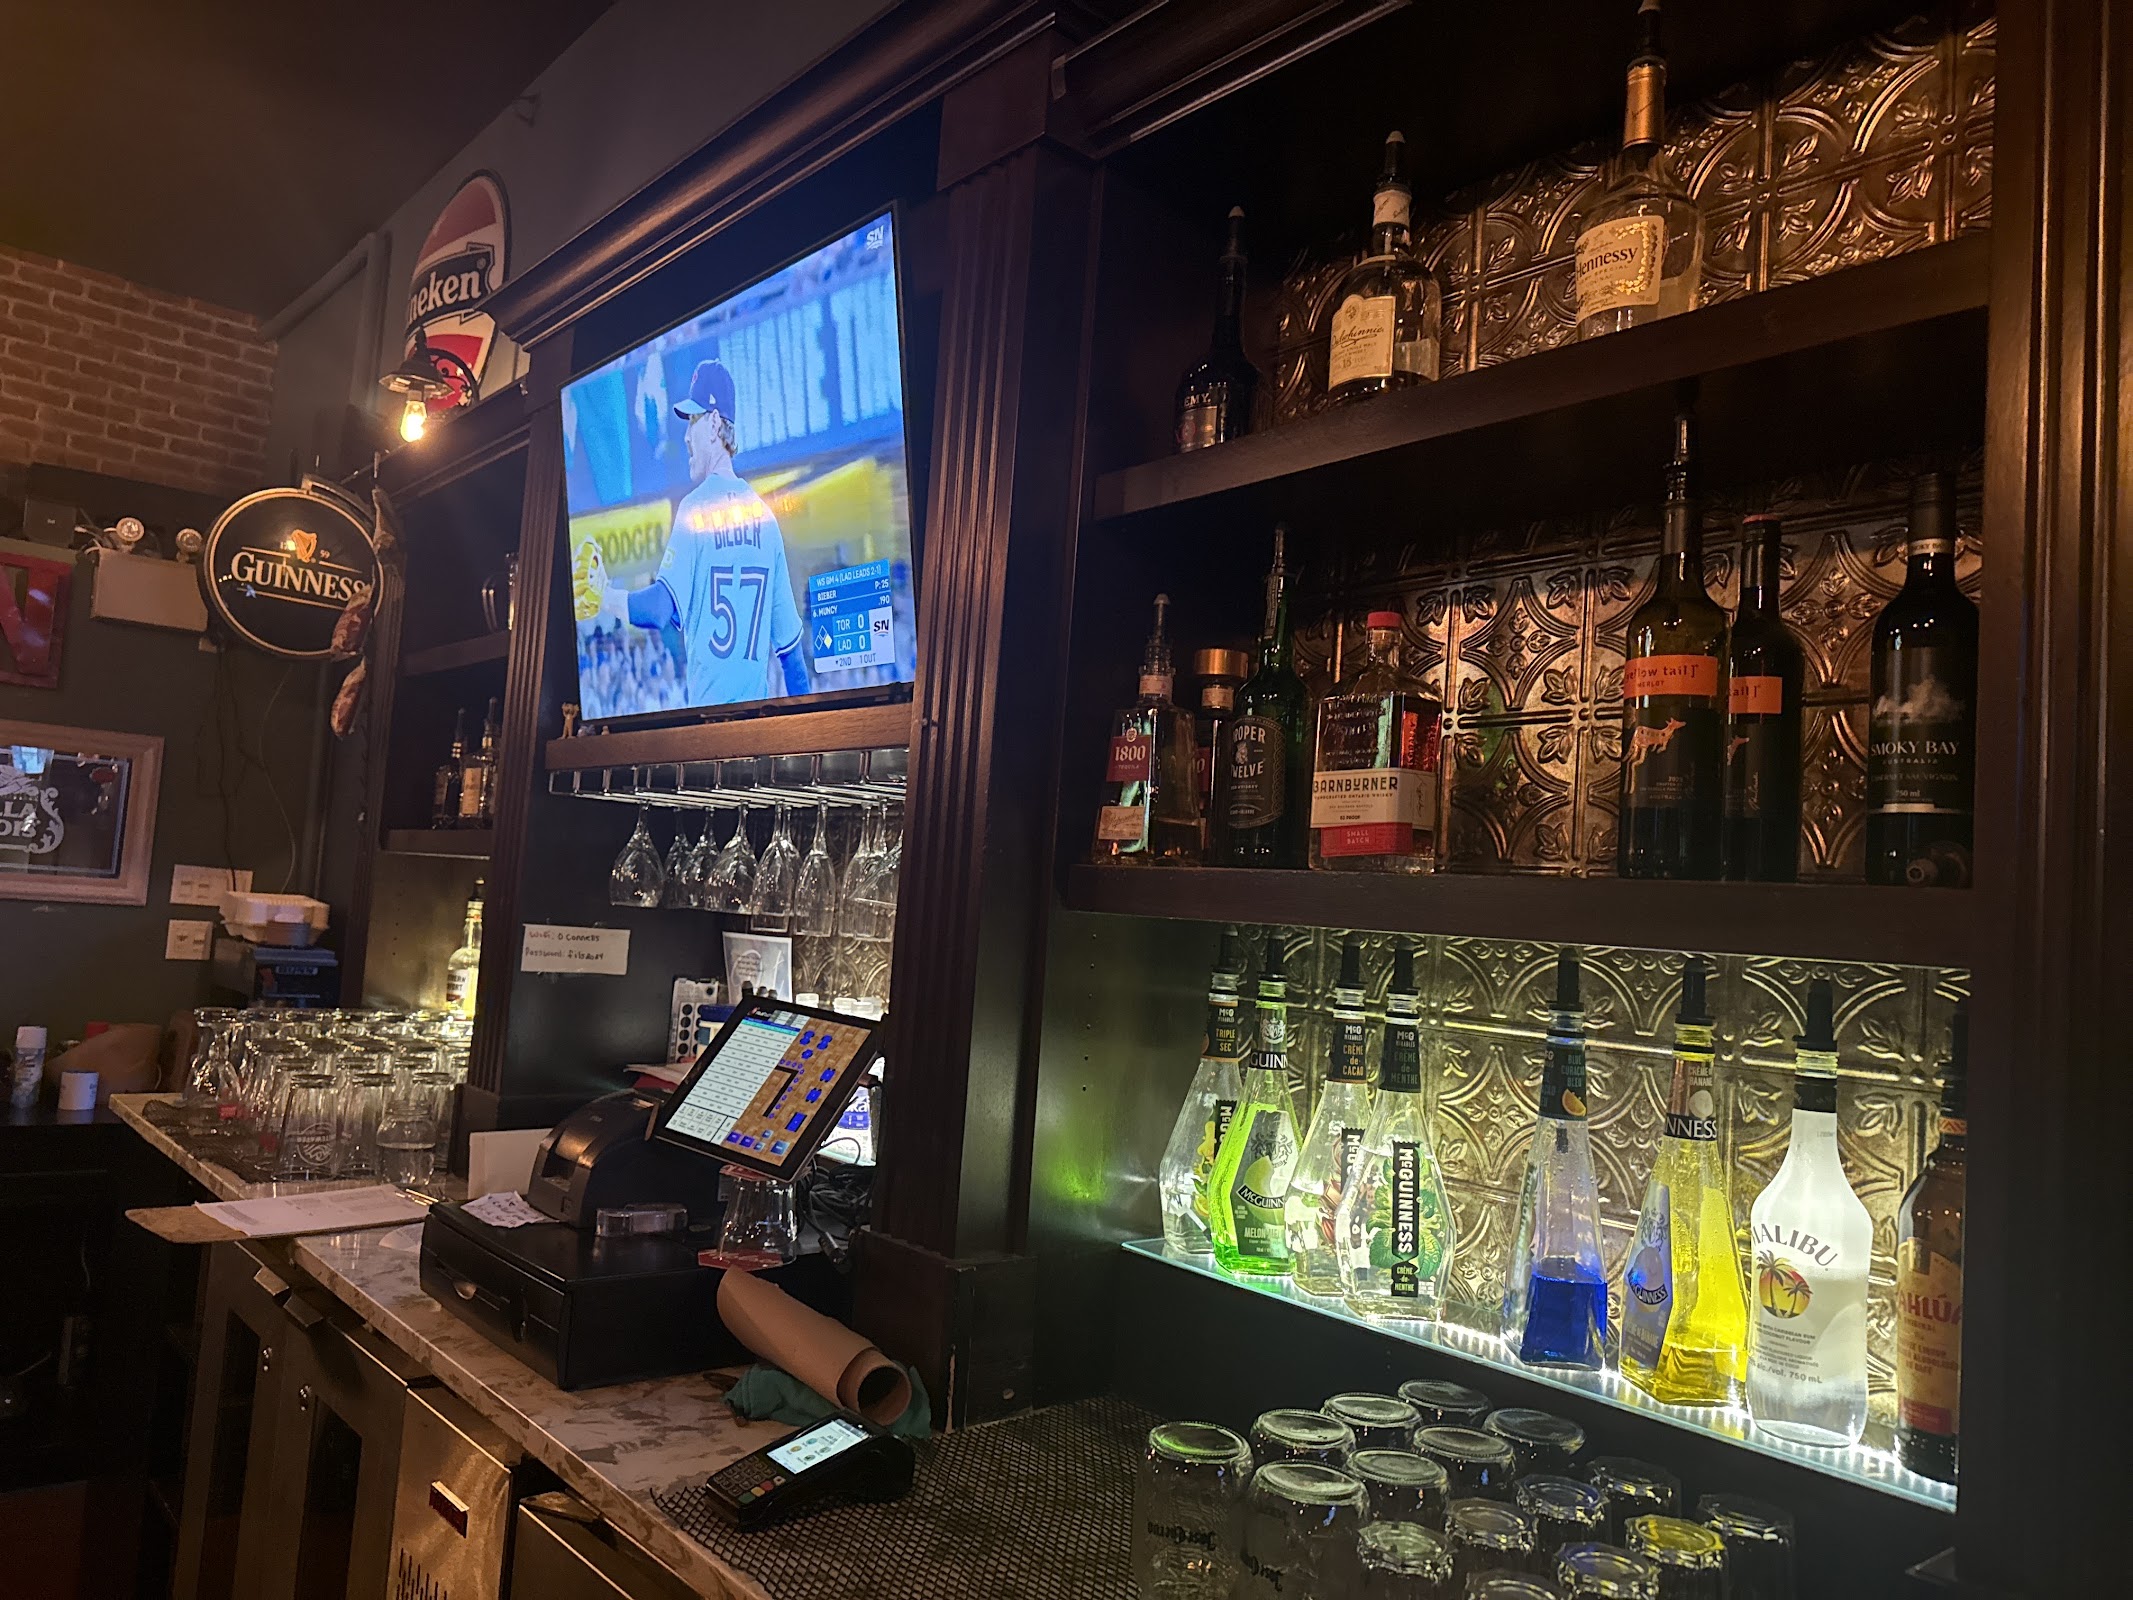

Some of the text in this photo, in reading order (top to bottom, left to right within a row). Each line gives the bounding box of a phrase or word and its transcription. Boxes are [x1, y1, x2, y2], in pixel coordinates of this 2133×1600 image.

[320, 549, 330, 558] 59
[231, 552, 366, 601] GUINNESS
[852, 568, 870, 581] LEADS
[817, 590, 837, 602] BIEBER
[709, 565, 769, 661] 57
[819, 605, 838, 616] MUNCY
[836, 614, 865, 631] TOR 0
[873, 619, 890, 632] SN
[838, 635, 866, 651] LAD 0
[839, 657, 852, 666] 2ND
[864, 653, 876, 663] OUT
[1115, 745, 1146, 761] 1800
[1871, 741, 1959, 756] SMOKY BAY
[1347, 837, 1370, 845] BATCH
[1215, 1028, 1236, 1039] TRIPLE
[1219, 1043, 1232, 1052] SEC
[1568, 1054, 1582, 1064] BLUE
[1342, 1065, 1364, 1077] CACAO
[1391, 1072, 1418, 1085] MENTHE
[1567, 1078, 1582, 1087] BLEU
[1398, 1149, 1414, 1253] McGUINNESS
[1394, 1283, 1415, 1292] MENTHE
[1774, 1326, 1802, 1337] CARIBBEAN
[1803, 1332, 1816, 1340] RUM
[1785, 1336, 1811, 1345] FLAVOUR
[1789, 1371, 1807, 1381] 750
